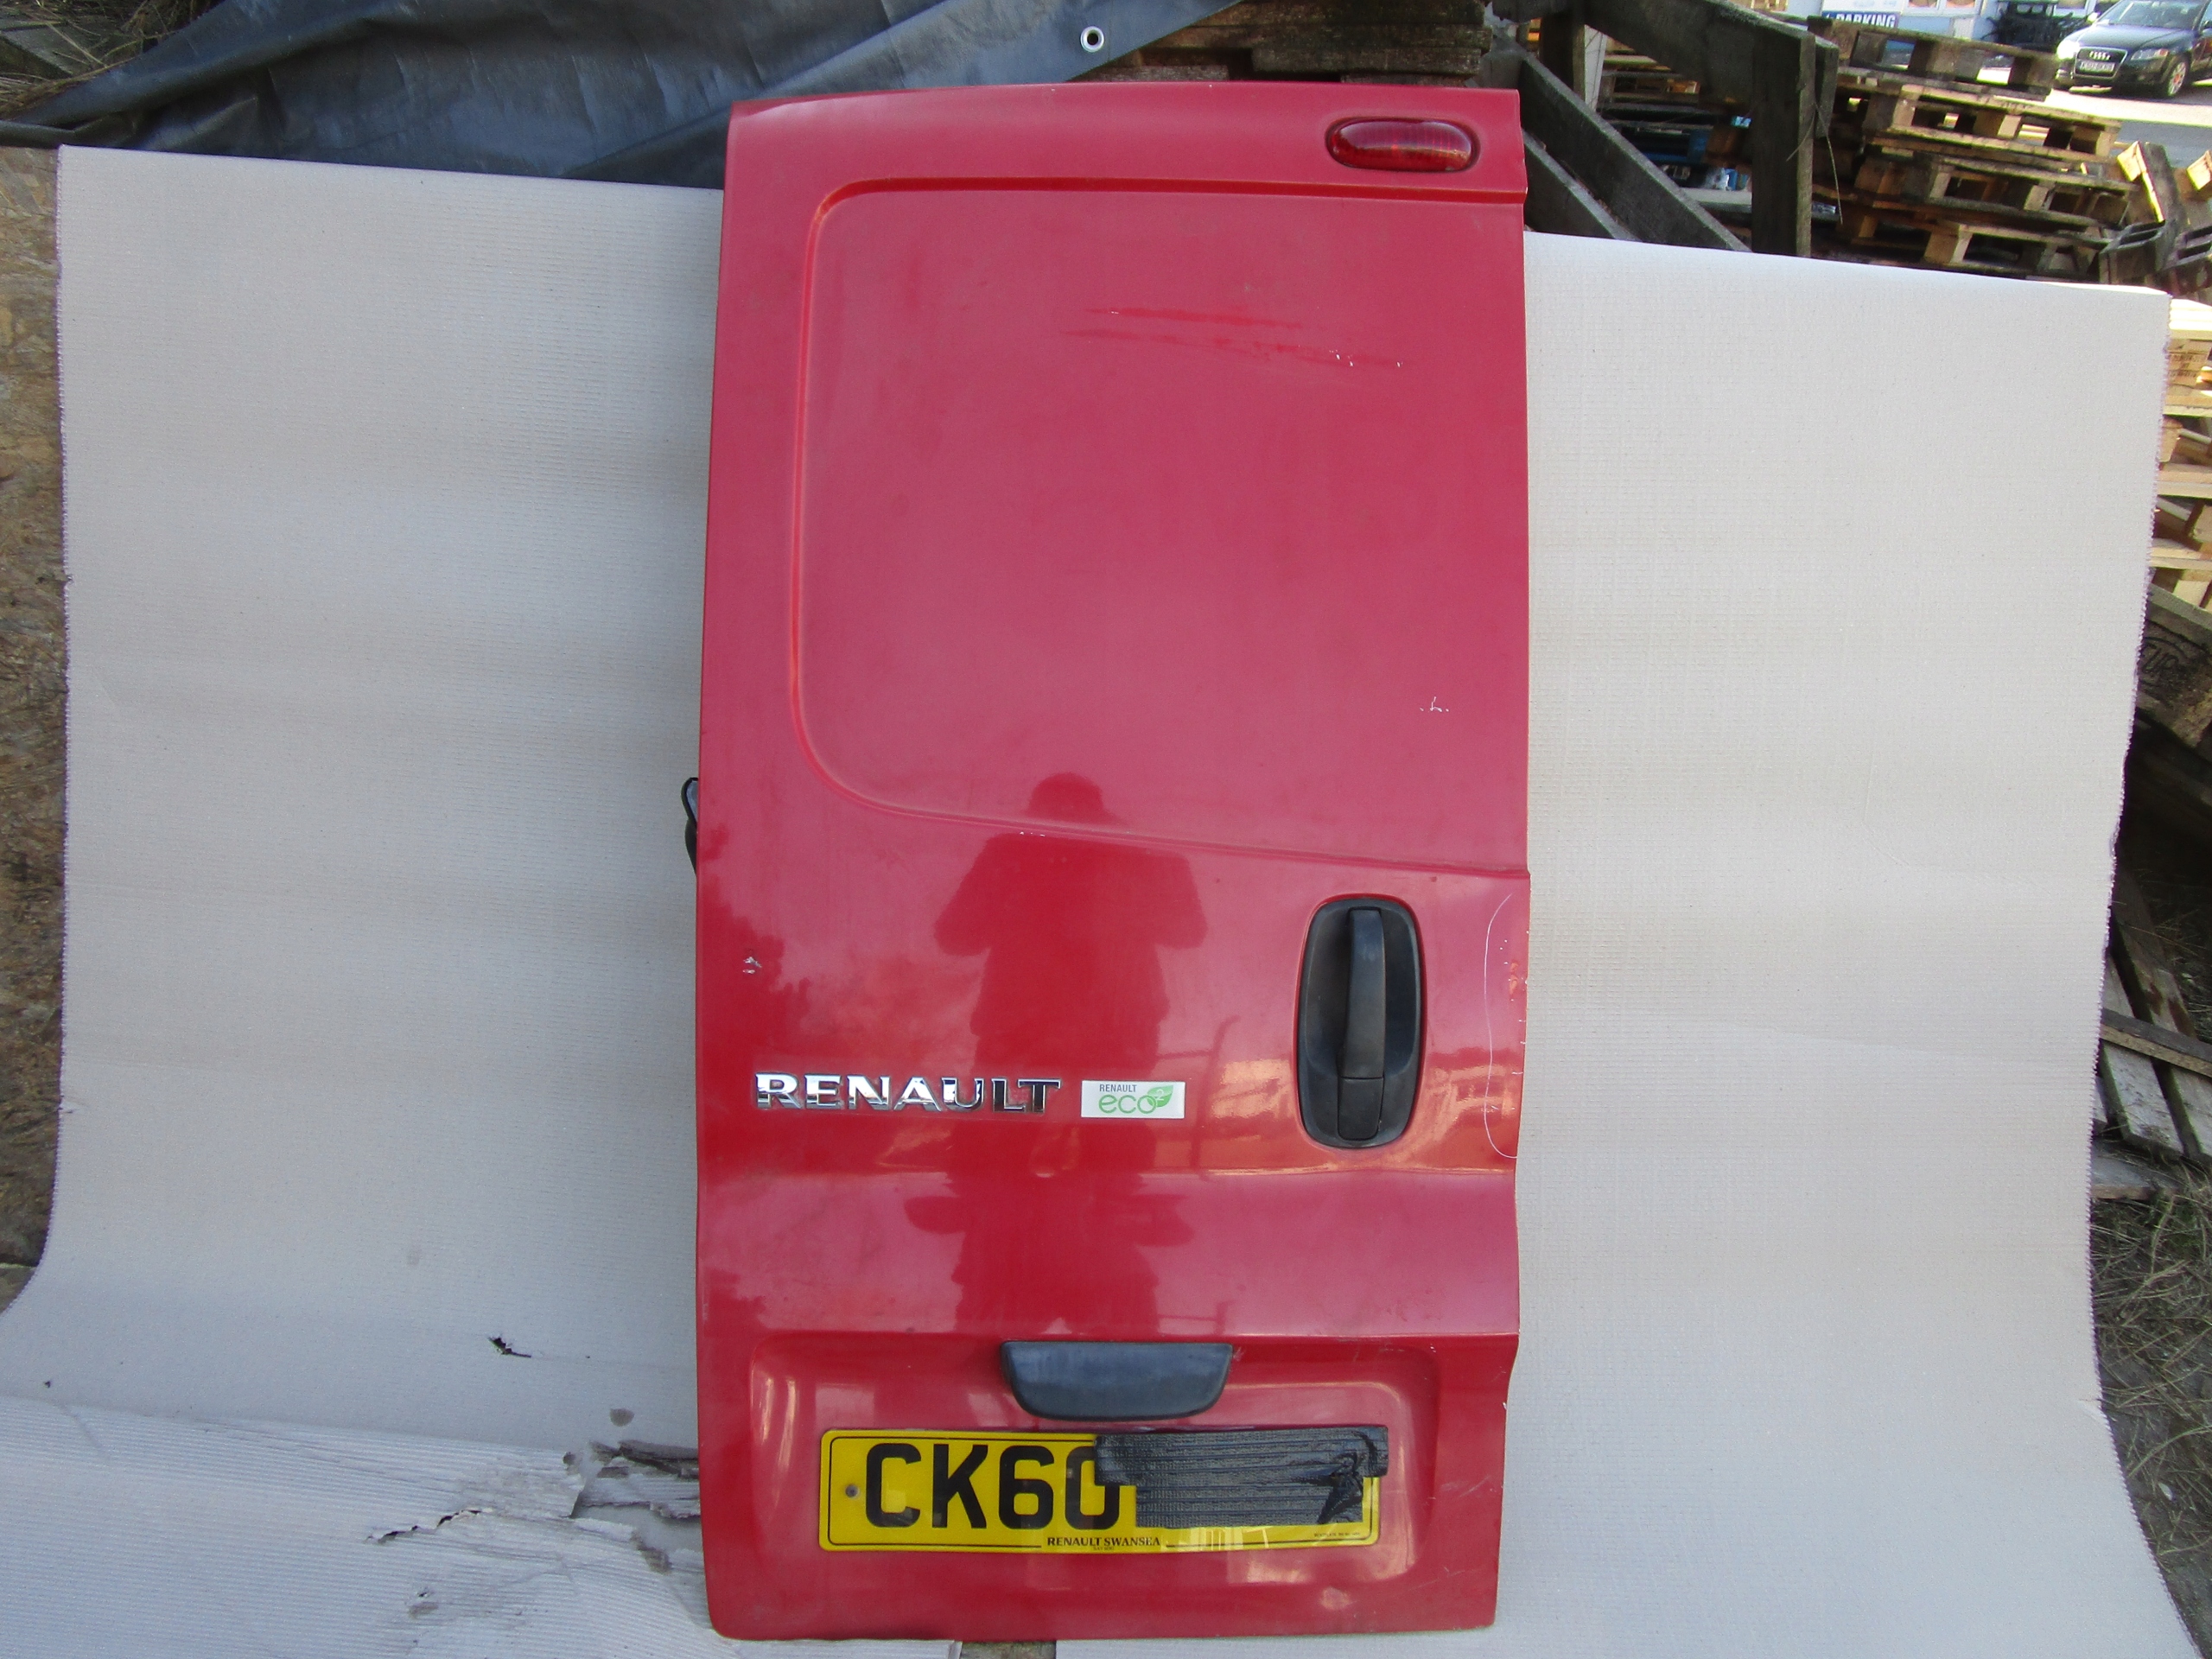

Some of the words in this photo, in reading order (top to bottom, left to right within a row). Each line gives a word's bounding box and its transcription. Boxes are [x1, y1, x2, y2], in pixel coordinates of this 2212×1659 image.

[755, 1072, 1062, 1114] RENAULT
[1099, 1084, 1137, 1093] RENAULT
[865, 1442, 1121, 1530] CK60
[1047, 1537, 1102, 1547] RENAULT
[1103, 1536, 1160, 1547] SWANSEA
